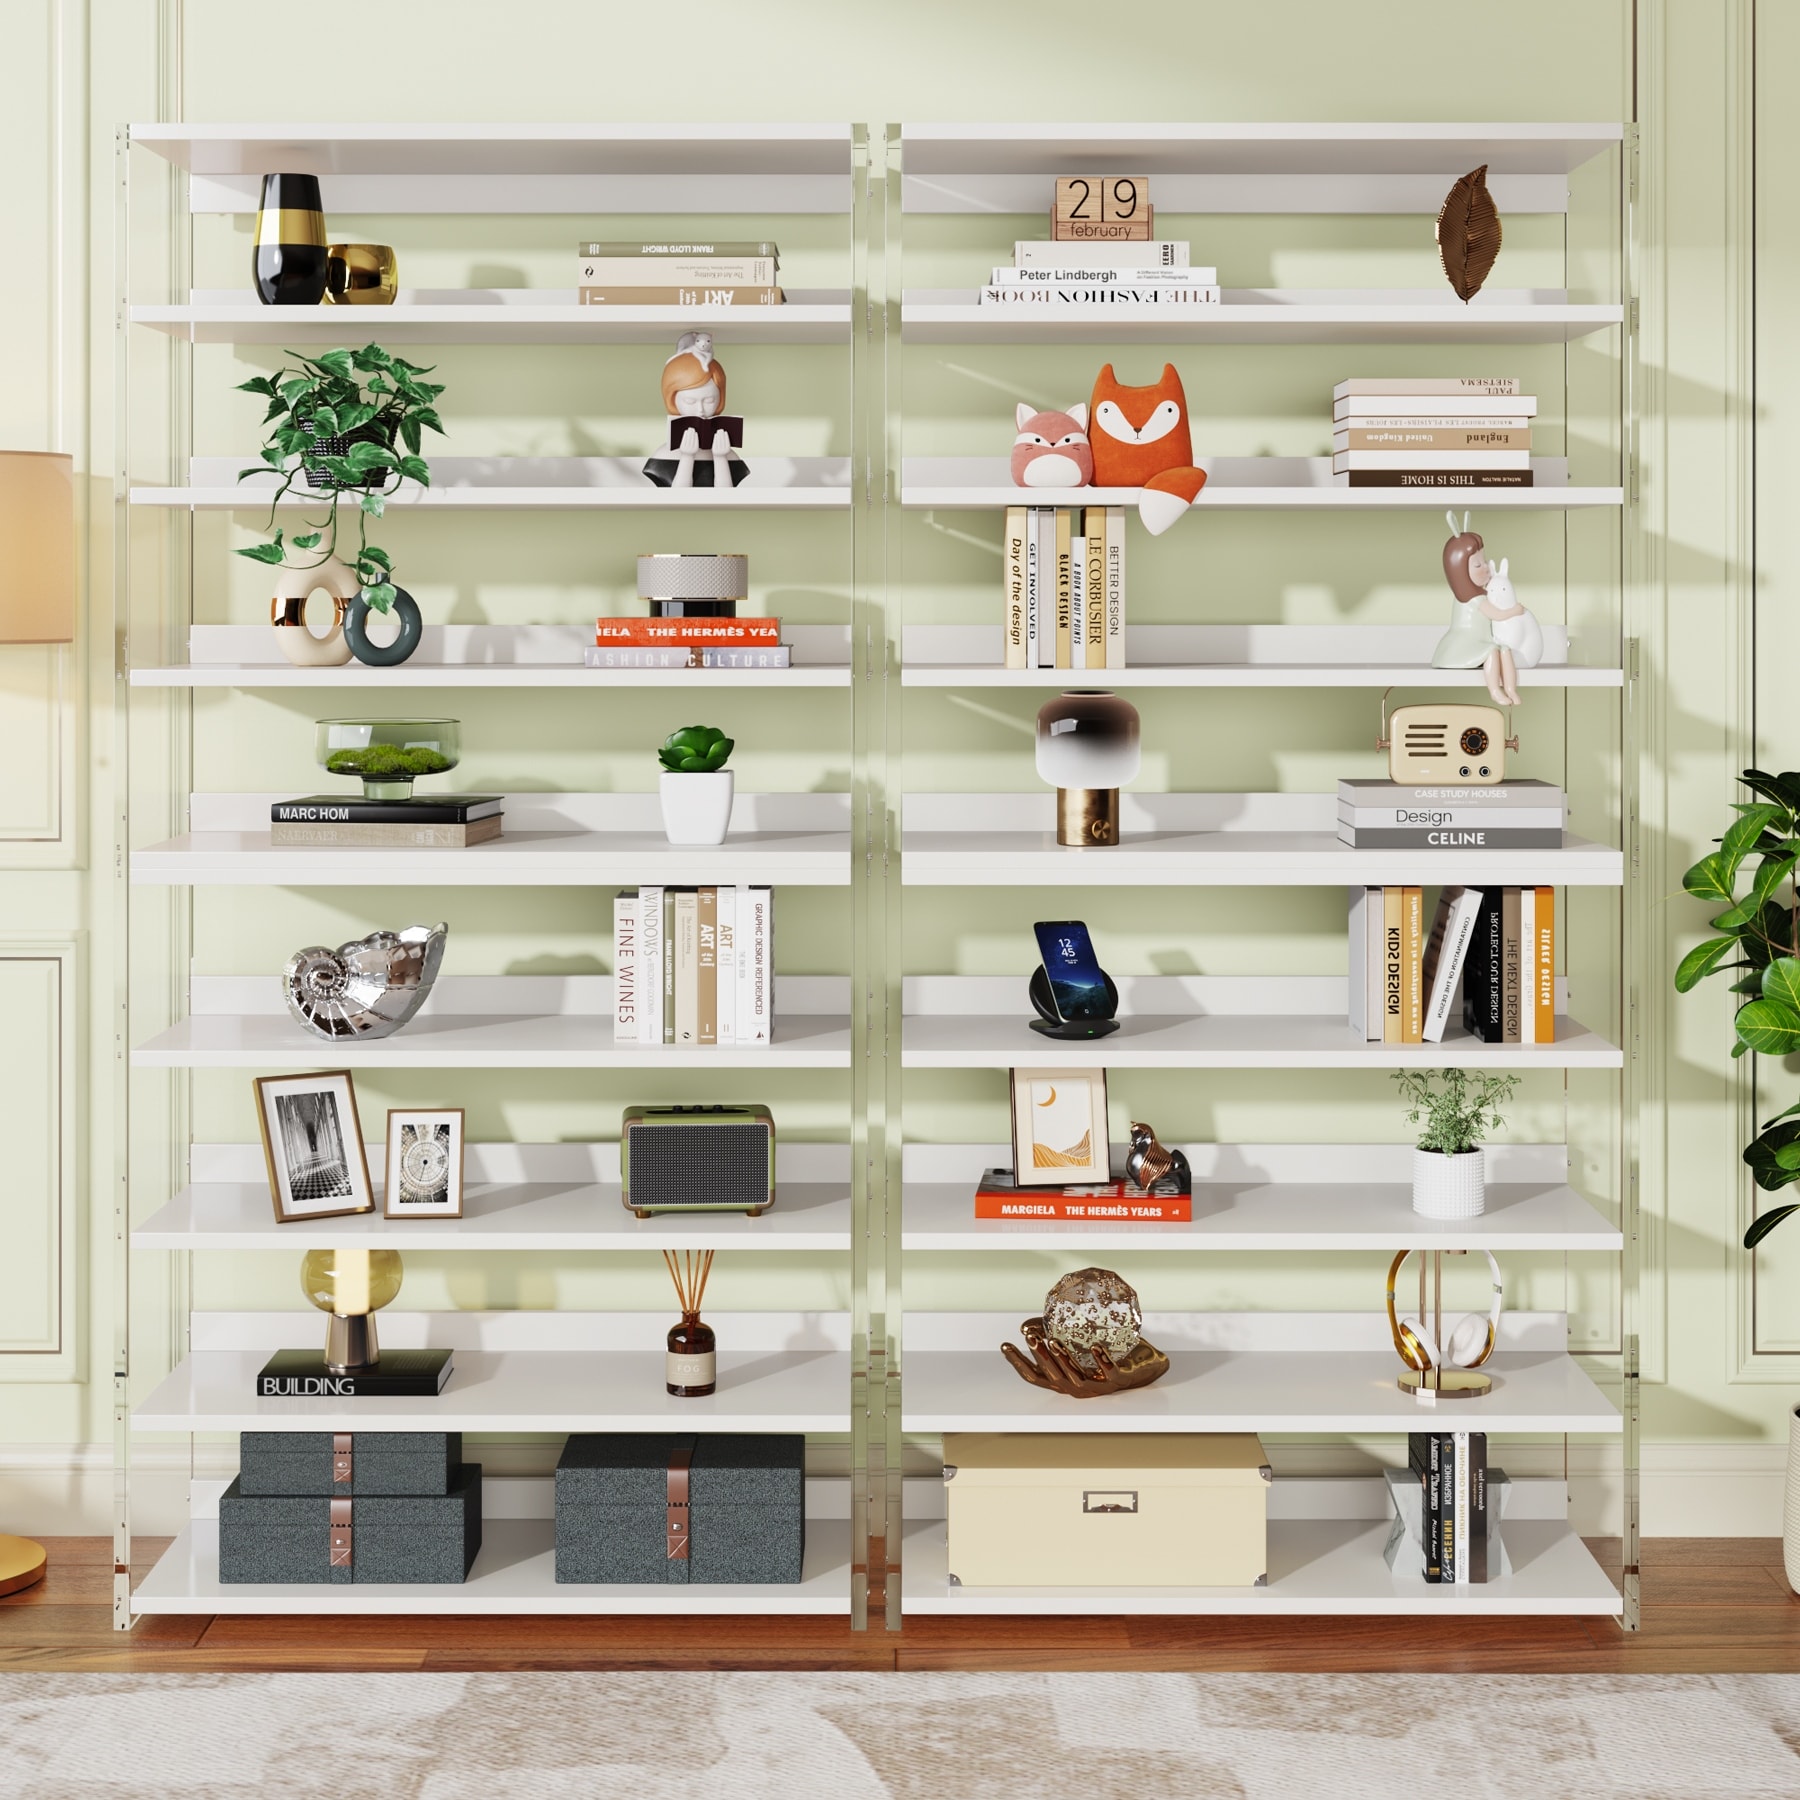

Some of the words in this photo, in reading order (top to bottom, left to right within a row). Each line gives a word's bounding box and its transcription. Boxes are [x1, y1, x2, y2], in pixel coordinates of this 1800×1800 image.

[1070, 222, 1132, 240] february
[641, 244, 669, 253] WRIGHT
[670, 244, 691, 253] LLOYD
[692, 244, 714, 253] FRANK
[1162, 244, 1170, 266] EERO
[724, 271, 733, 279] Art
[733, 271, 744, 279] The
[1020, 269, 1052, 281] Peter
[1054, 269, 1118, 283] Lindbergh
[703, 289, 734, 305] ART
[986, 290, 1049, 304] BOOK
[1058, 290, 1158, 303] FASHION
[1165, 290, 1217, 303] THE
[1366, 432, 1403, 442] Kingdom
[1406, 434, 1433, 442] United
[1466, 432, 1509, 444] England
[1401, 475, 1434, 485] HOME
[1437, 475, 1447, 485] IS
[1449, 475, 1475, 485] THIS
[1011, 537, 1022, 562] Day
[1089, 537, 1102, 555] LE
[1012, 566, 1022, 578] of
[1059, 554, 1069, 586] BLACK
[1110, 546, 1119, 587] BETTER
[1012, 582, 1022, 601] the
[1089, 559, 1102, 645] CORBUSIER
[1059, 591, 1069, 629] DESIGN
[1110, 592, 1119, 636] DESIGN
[596, 627, 631, 637] IELA
[647, 627, 677, 637] THE
[681, 626, 745, 637] HERMÈS
[748, 627, 778, 637] YEA
[1010, 605, 1022, 645] design
[585, 652, 670, 666] ASHION
[687, 653, 782, 667] CULTURE
[1414, 789, 1439, 798] CASE
[1440, 789, 1470, 798] STUDY
[1472, 789, 1508, 798] HOUSES
[279, 807, 317, 820] MARC
[319, 807, 349, 820] HOM
[1395, 809, 1453, 826] Design
[1427, 832, 1486, 845] CELINE
[644, 892, 658, 957] WINDOWS
[755, 903, 763, 936] GRAPHIC
[619, 918, 634, 957] FINE
[701, 924, 714, 949] ART
[720, 924, 733, 949] ART
[1059, 939, 1072, 948] 12
[755, 938, 763, 965] DESIGN
[1061, 948, 1076, 957] 45
[618, 965, 635, 1023] WINES
[755, 967, 763, 1015] REFERENCED
[1001, 1204, 1055, 1215] MARGIELA
[1065, 1205, 1086, 1216] THE
[1087, 1203, 1129, 1216] HERMÈS
[1131, 1207, 1162, 1217] YEARS
[677, 1365, 700, 1373] FOG
[263, 1377, 355, 1395] BUILDING
[1444, 1463, 1452, 1505] ИЗБРАННОЕ
[1459, 1489, 1465, 1501] НА
[1443, 1519, 1453, 1559] ЕСЕНИН
